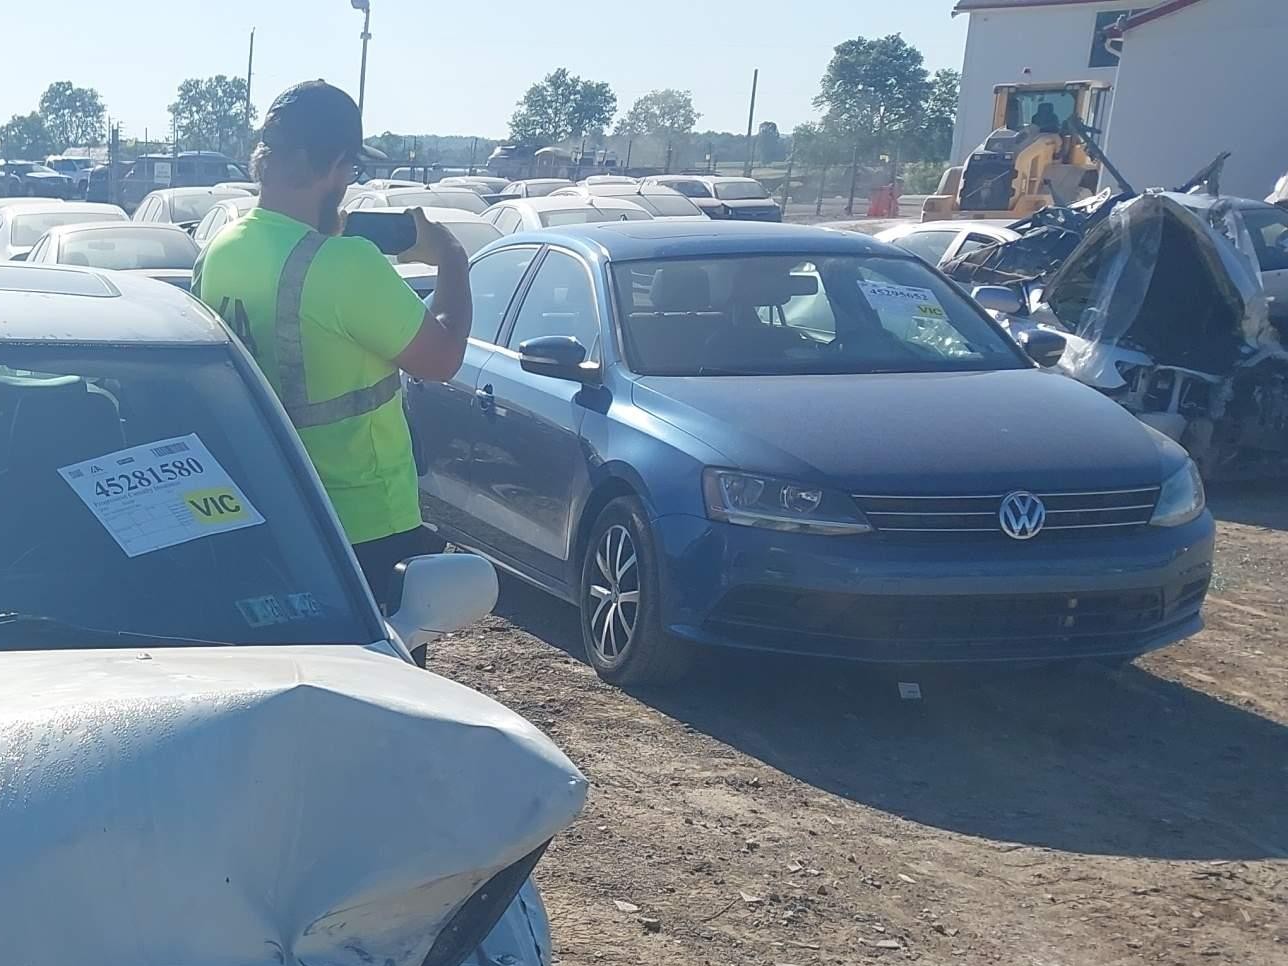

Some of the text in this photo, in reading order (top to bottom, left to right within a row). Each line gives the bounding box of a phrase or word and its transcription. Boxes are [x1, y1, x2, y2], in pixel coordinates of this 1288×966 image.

[918, 305, 943, 315] VIC
[95, 457, 204, 497] 45281580
[189, 494, 241, 517] VIC
[1000, 493, 1045, 538] VW
